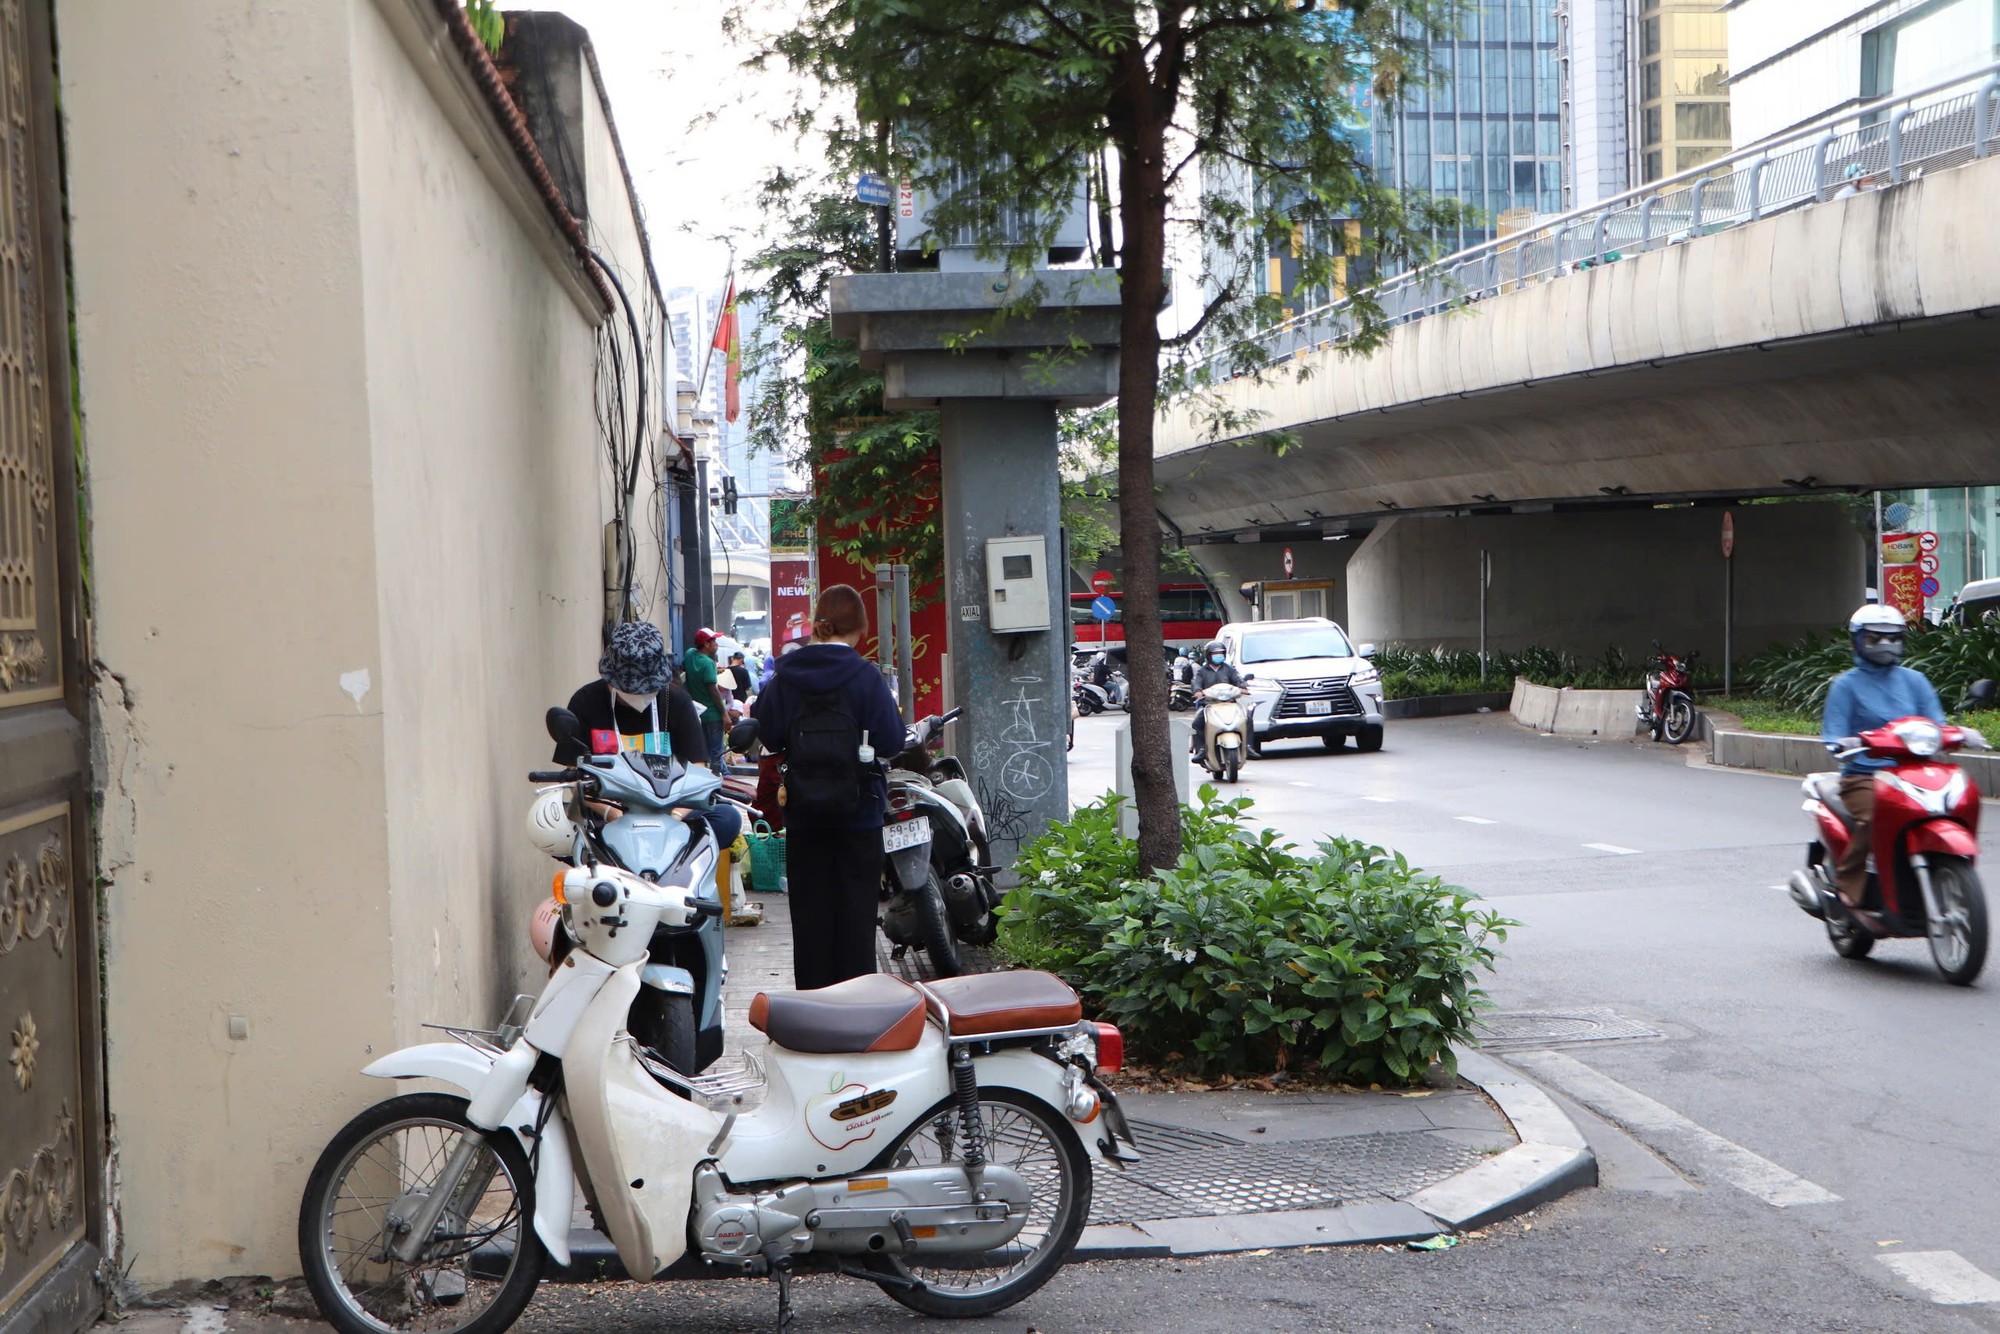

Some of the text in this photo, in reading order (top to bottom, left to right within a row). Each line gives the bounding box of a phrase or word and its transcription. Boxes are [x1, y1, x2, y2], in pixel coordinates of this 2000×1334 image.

[777, 586, 807, 597] NEW
[962, 607, 980, 617] AXIAL
[863, 634, 930, 660] 26
[889, 820, 920, 838] 59-G1
[846, 1115, 881, 1131] DAELIM
